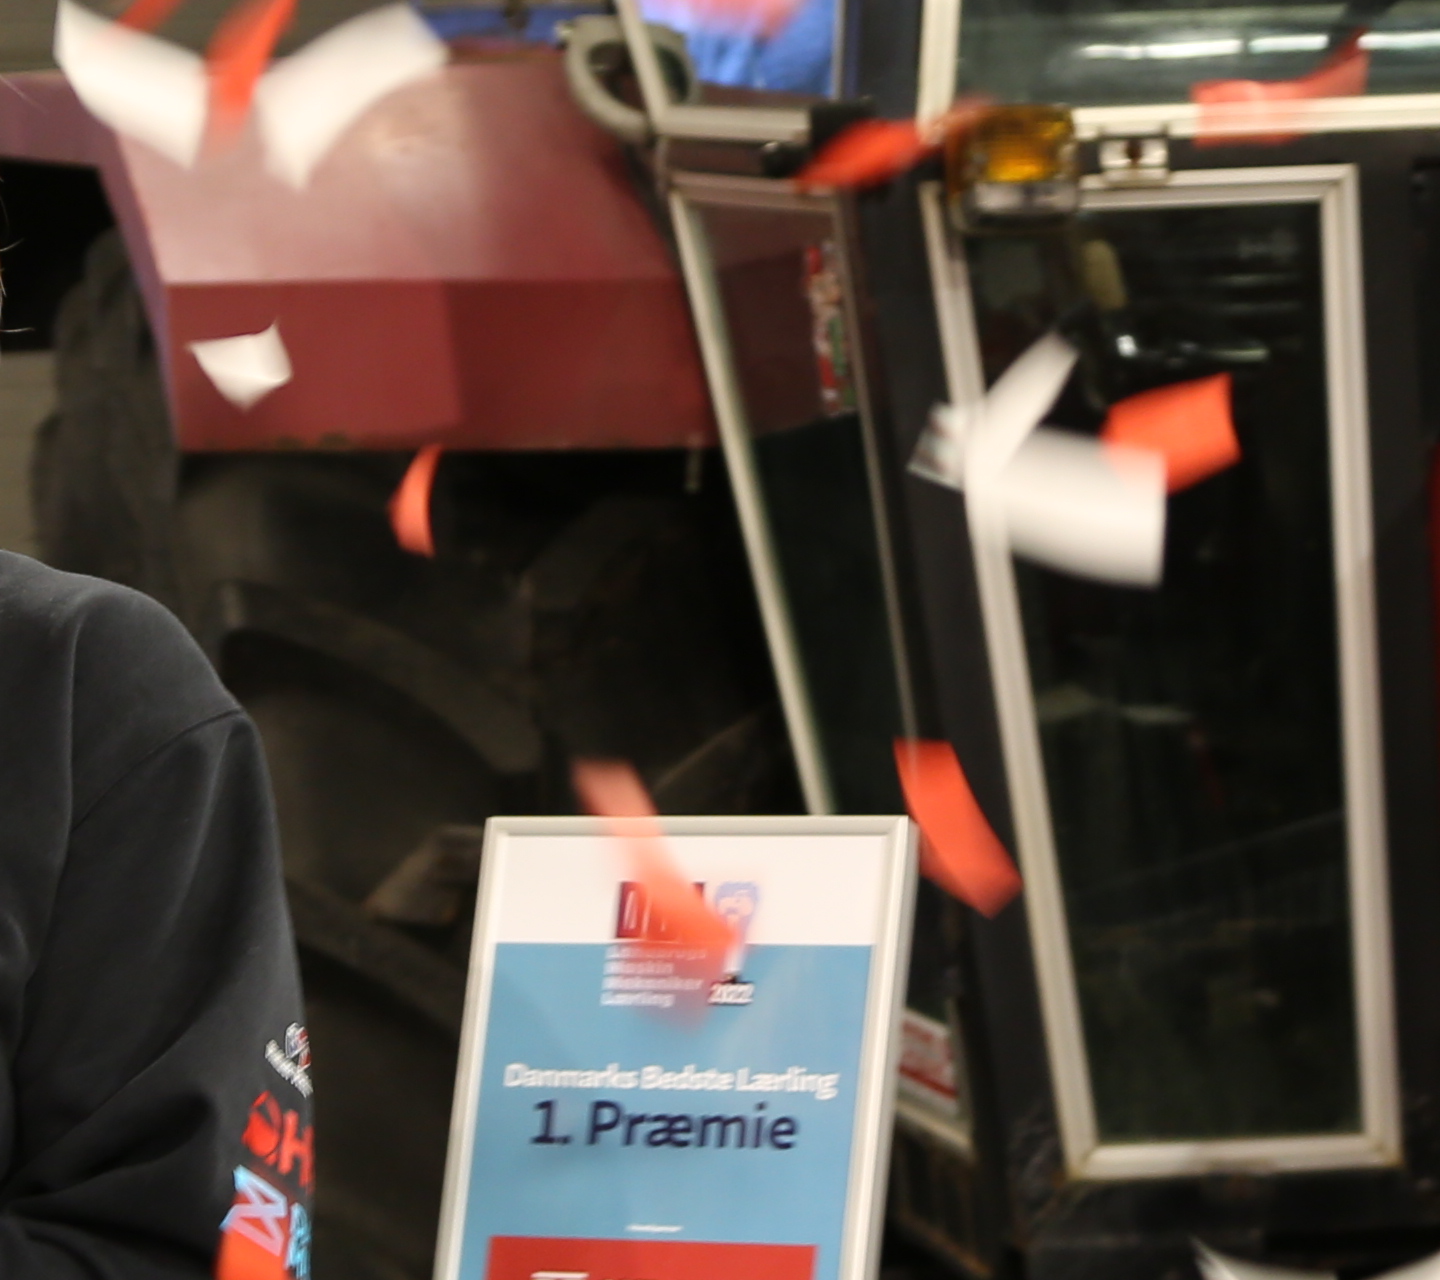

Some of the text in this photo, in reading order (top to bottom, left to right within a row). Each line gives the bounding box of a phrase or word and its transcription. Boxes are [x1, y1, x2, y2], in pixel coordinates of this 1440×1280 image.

[504, 1062, 840, 1100] Danmarks Bedste Lærling
[530, 1099, 797, 1151] 1. Præmie
